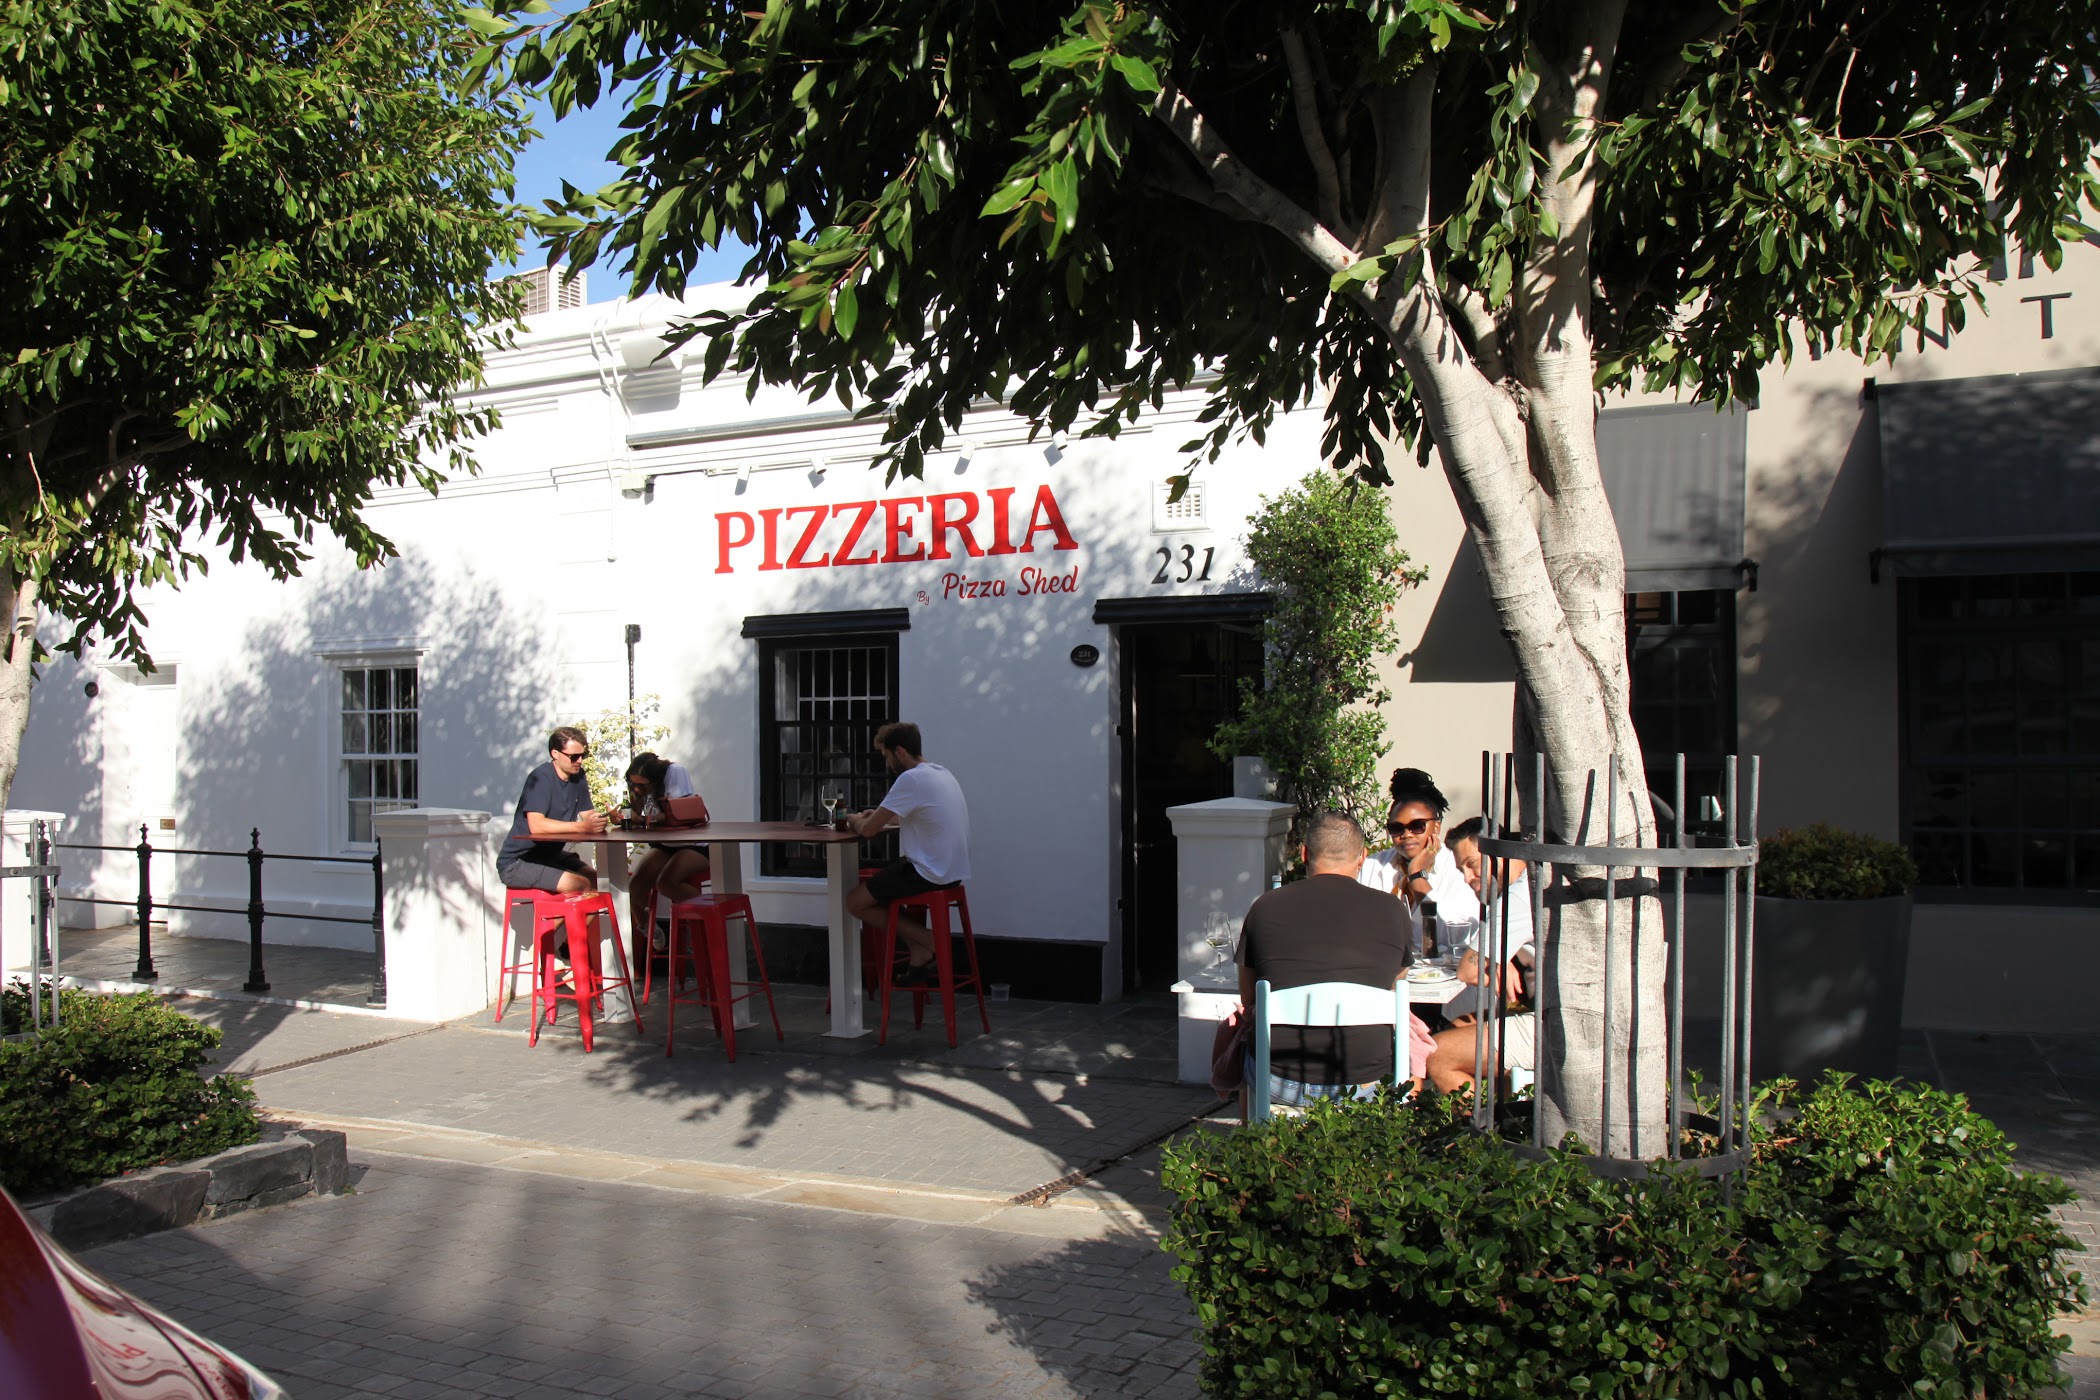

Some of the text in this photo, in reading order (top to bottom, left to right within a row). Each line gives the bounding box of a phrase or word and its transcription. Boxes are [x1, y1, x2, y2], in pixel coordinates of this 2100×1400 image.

[714, 483, 1079, 575] PIZZERIA
[1150, 543, 1216, 585] 231
[916, 565, 1080, 606] By Pizza Shed
